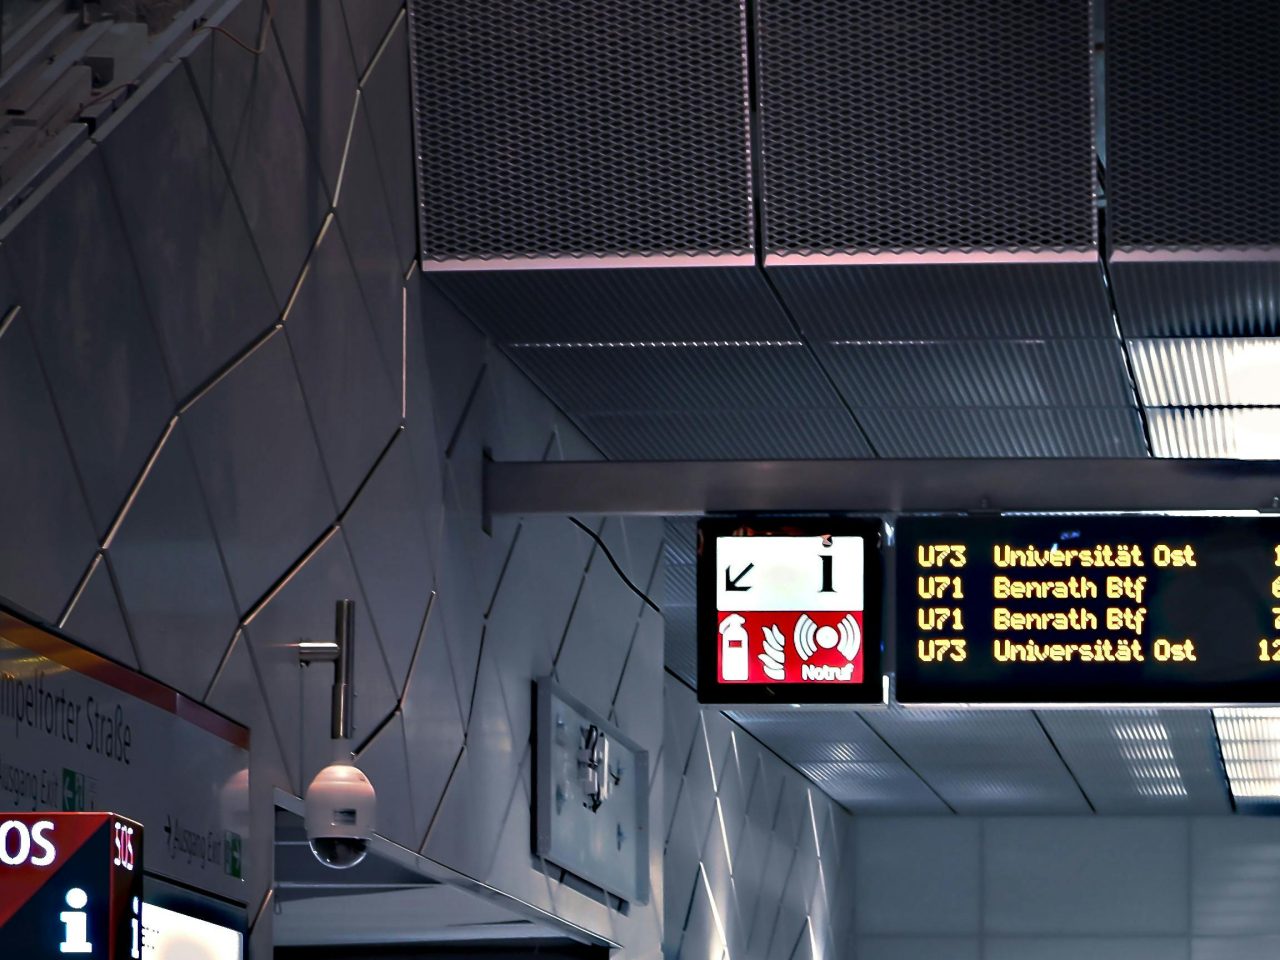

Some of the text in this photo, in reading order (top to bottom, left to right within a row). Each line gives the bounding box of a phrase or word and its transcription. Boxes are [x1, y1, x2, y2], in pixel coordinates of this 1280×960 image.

[918, 544, 967, 568] U73
[993, 544, 1145, 568] Universität
[1153, 544, 1197, 568] Ost
[918, 576, 964, 600] U71
[993, 576, 1098, 600] Benrath
[1106, 576, 1147, 604] Btf
[918, 607, 964, 631] U71
[993, 607, 1098, 631] Benrath
[1106, 607, 1147, 635] Btf
[918, 638, 967, 662] U73
[993, 638, 1145, 662] Universität
[1153, 638, 1197, 662] Ost
[801, 662, 855, 681] Notruf
[86, 696, 132, 765] Straße
[114, 821, 135, 871] SOS
